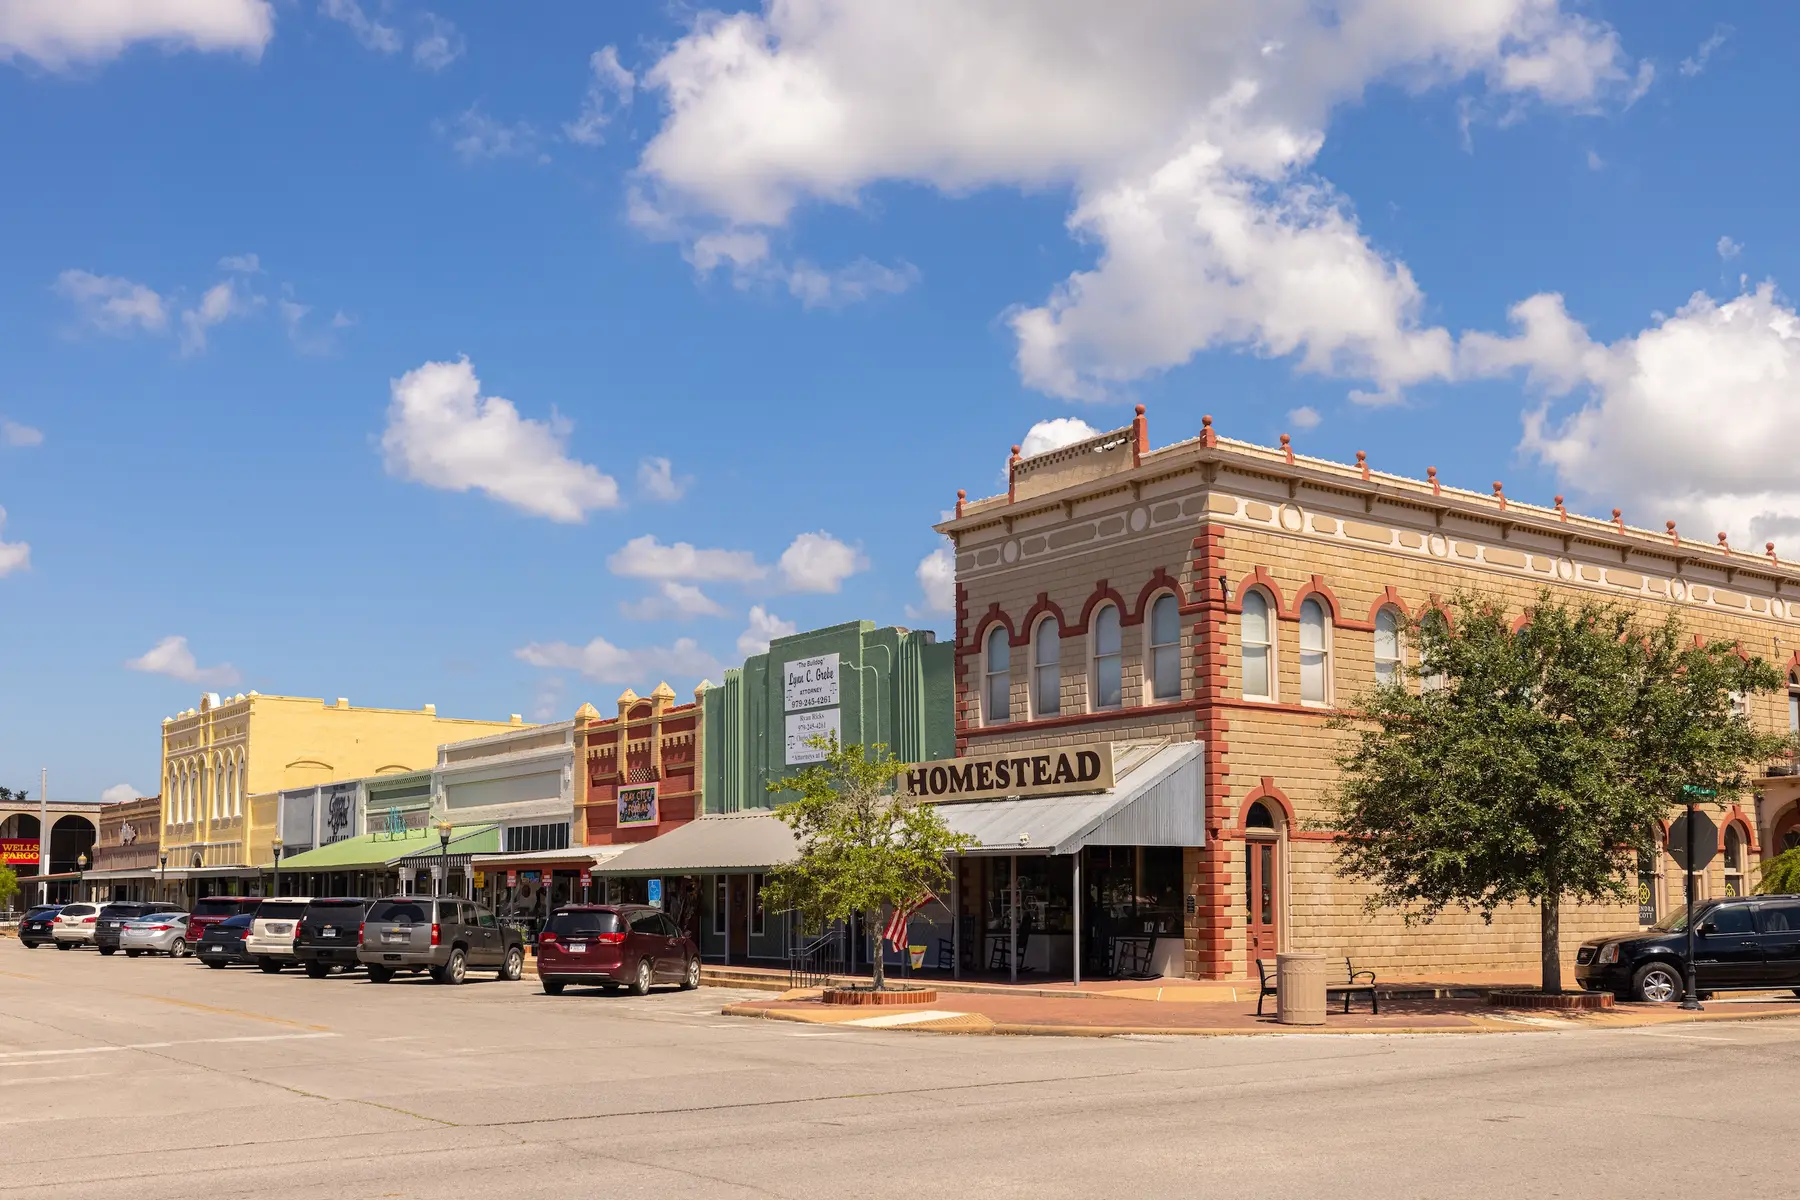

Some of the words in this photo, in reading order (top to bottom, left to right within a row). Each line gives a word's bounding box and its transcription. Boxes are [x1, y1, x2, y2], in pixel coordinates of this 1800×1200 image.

[806, 670, 813, 682] C.
[800, 687, 822, 695] ATTORNEY
[906, 750, 1100, 796] HOMESTEAD
[2, 852, 39, 860] FARGO
